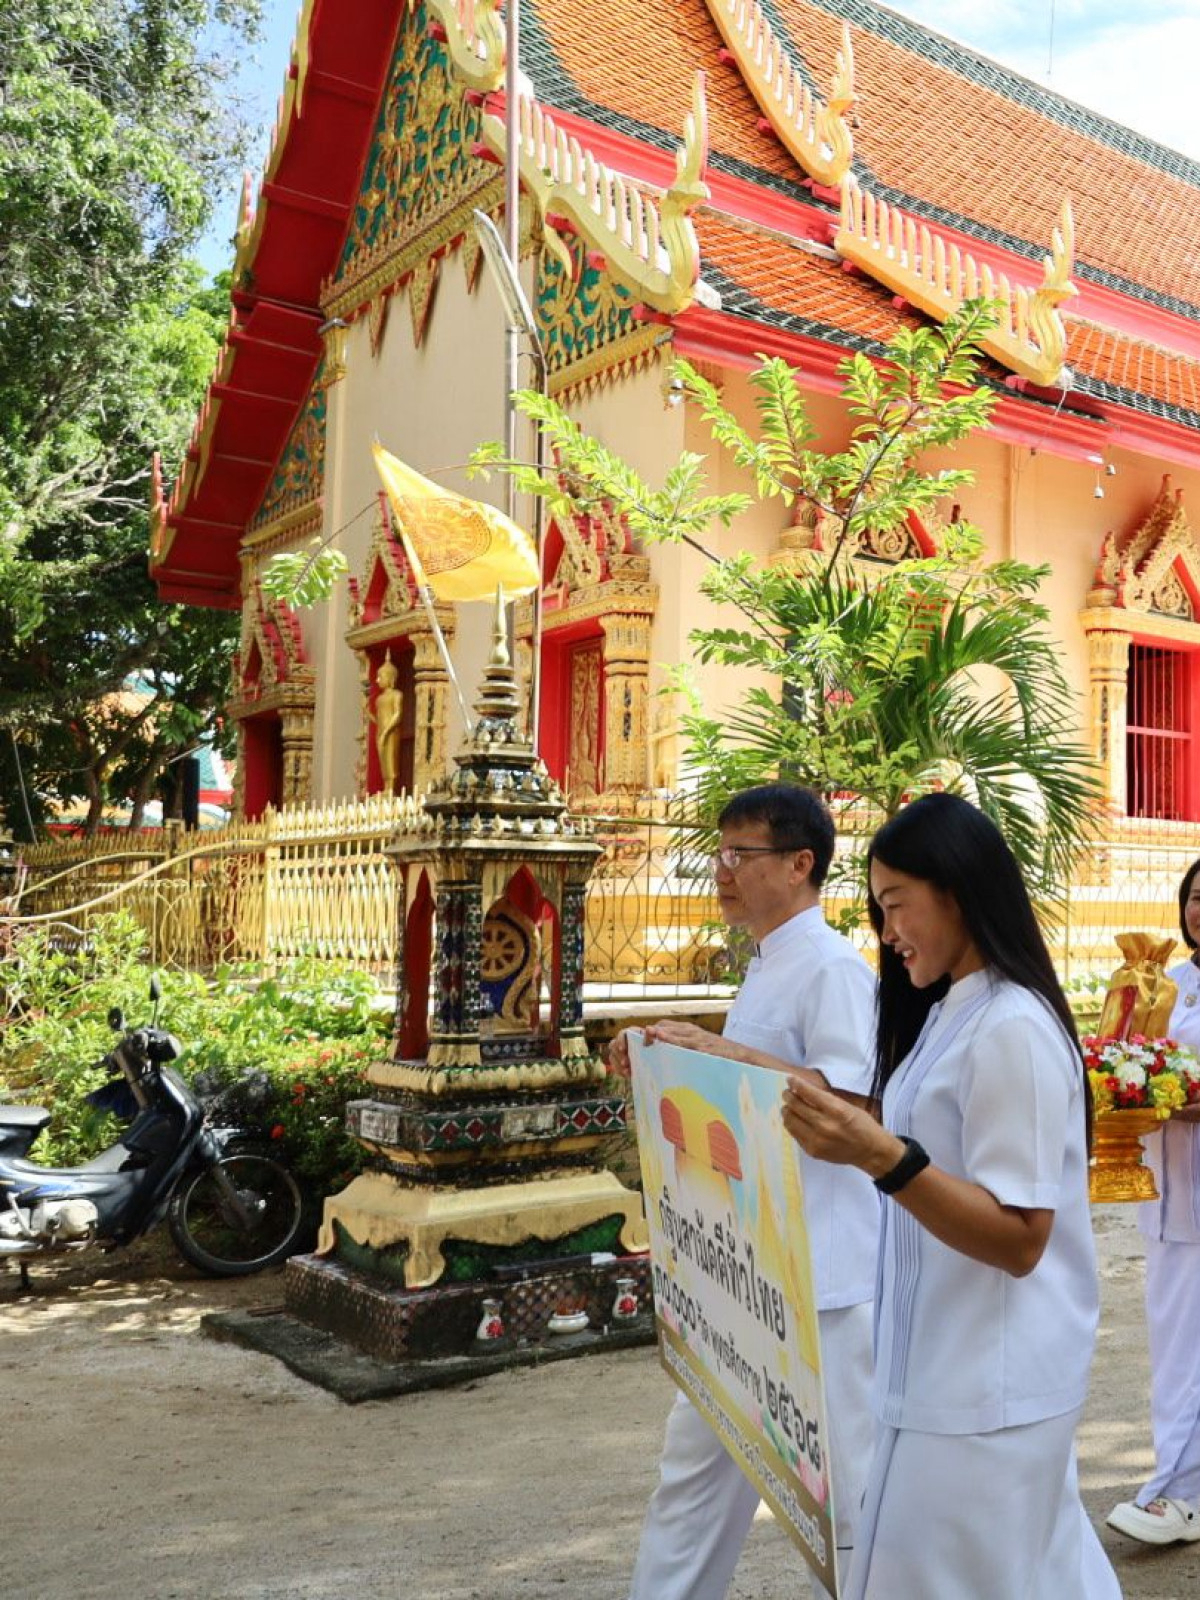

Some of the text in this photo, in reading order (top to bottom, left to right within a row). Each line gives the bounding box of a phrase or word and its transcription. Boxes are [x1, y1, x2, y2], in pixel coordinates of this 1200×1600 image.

[659, 1184, 786, 1342] กฐินสามัคคีทั่วไทย
[762, 1365, 821, 1472] ๒๕๖๘
